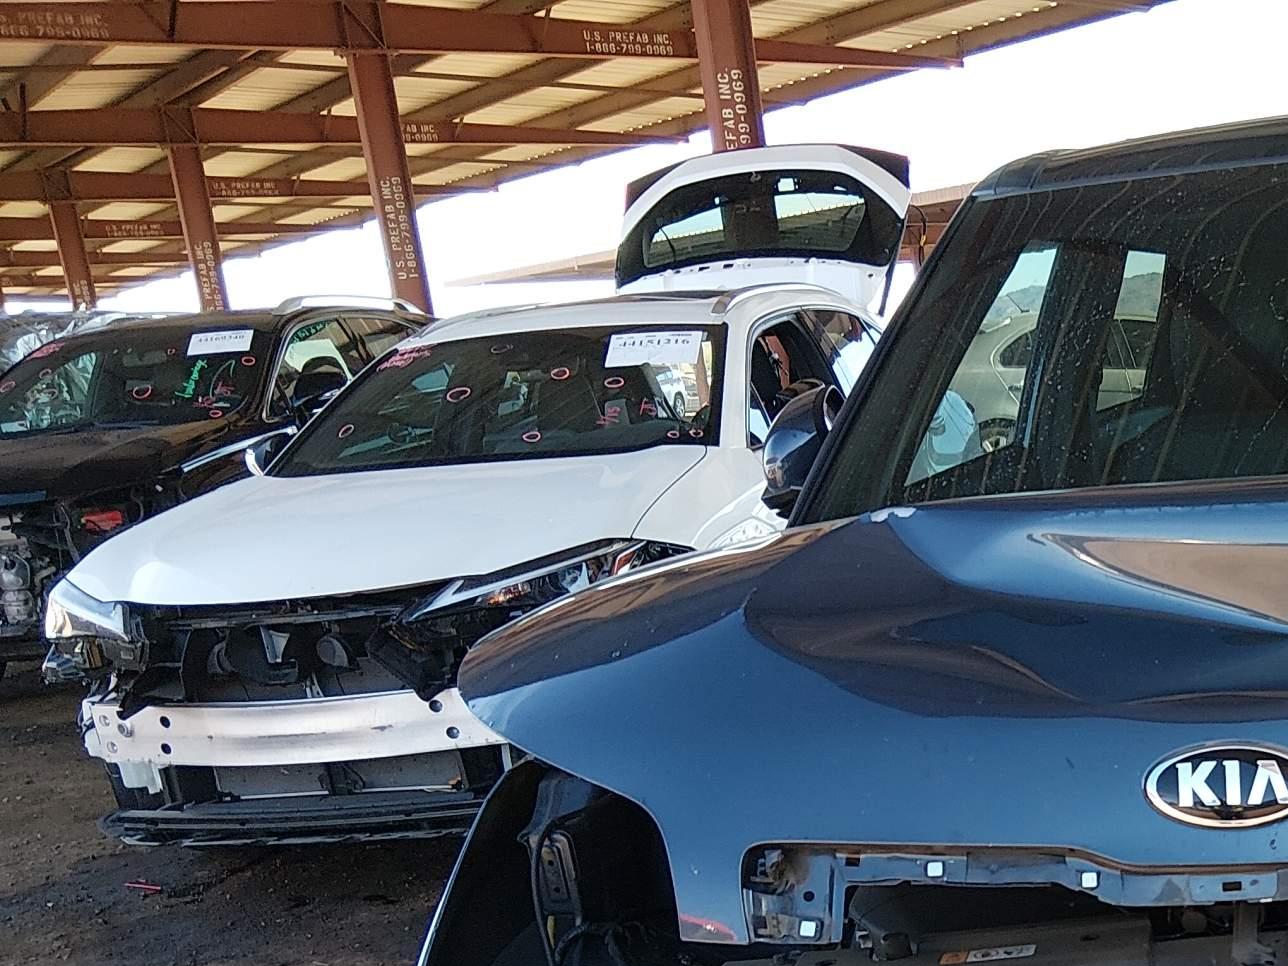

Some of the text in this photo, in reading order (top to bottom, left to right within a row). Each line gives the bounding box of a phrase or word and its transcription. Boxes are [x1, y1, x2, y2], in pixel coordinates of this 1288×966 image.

[583, 29, 673, 45] U.S. PREFAB INC.
[717, 67, 738, 150] EFAB INC.
[730, 69, 751, 144] 99-0969
[380, 176, 392, 199] INC.
[385, 204, 402, 251] PREFAB
[619, 338, 690, 347] 44151216
